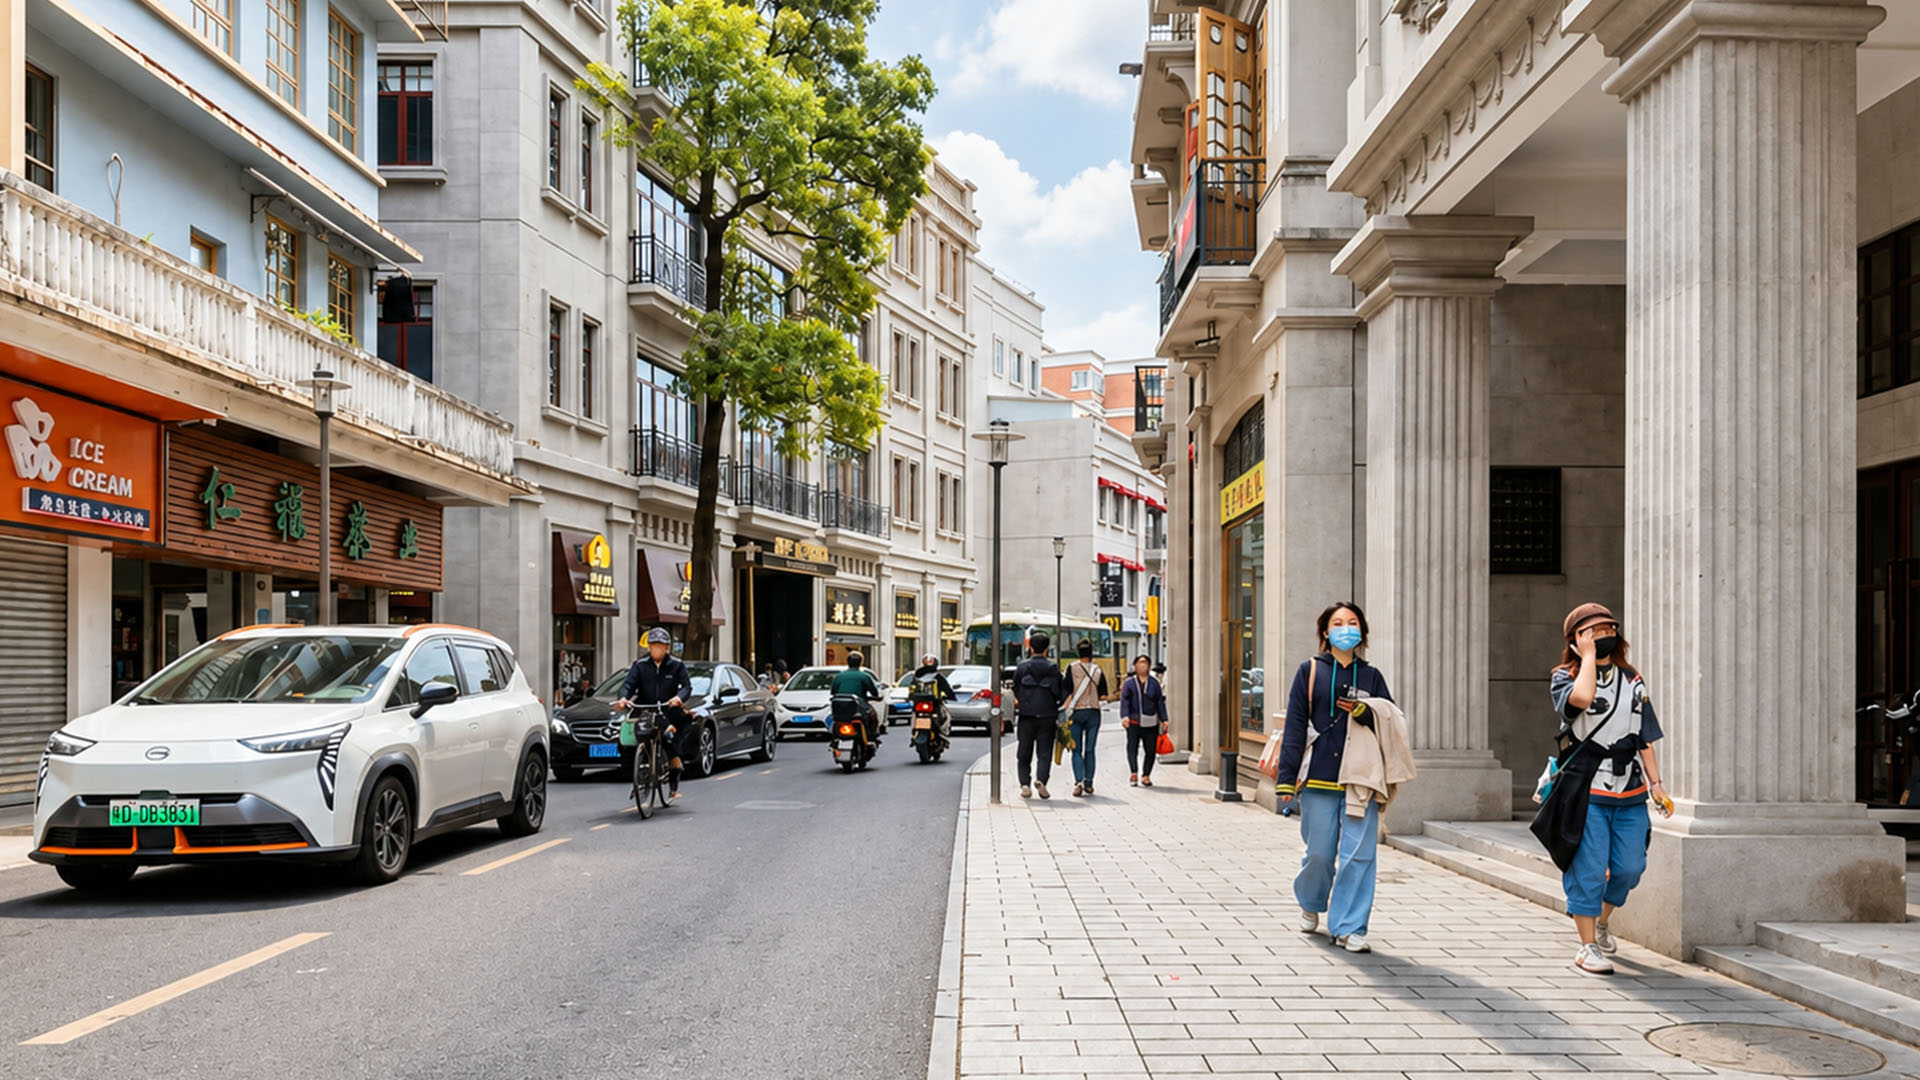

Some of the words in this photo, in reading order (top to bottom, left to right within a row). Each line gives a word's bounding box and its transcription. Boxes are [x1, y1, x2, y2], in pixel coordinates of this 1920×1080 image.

[71, 437, 105, 464] ICE
[69, 467, 133, 498] CREAM
[140, 805, 195, 823] DB3831
